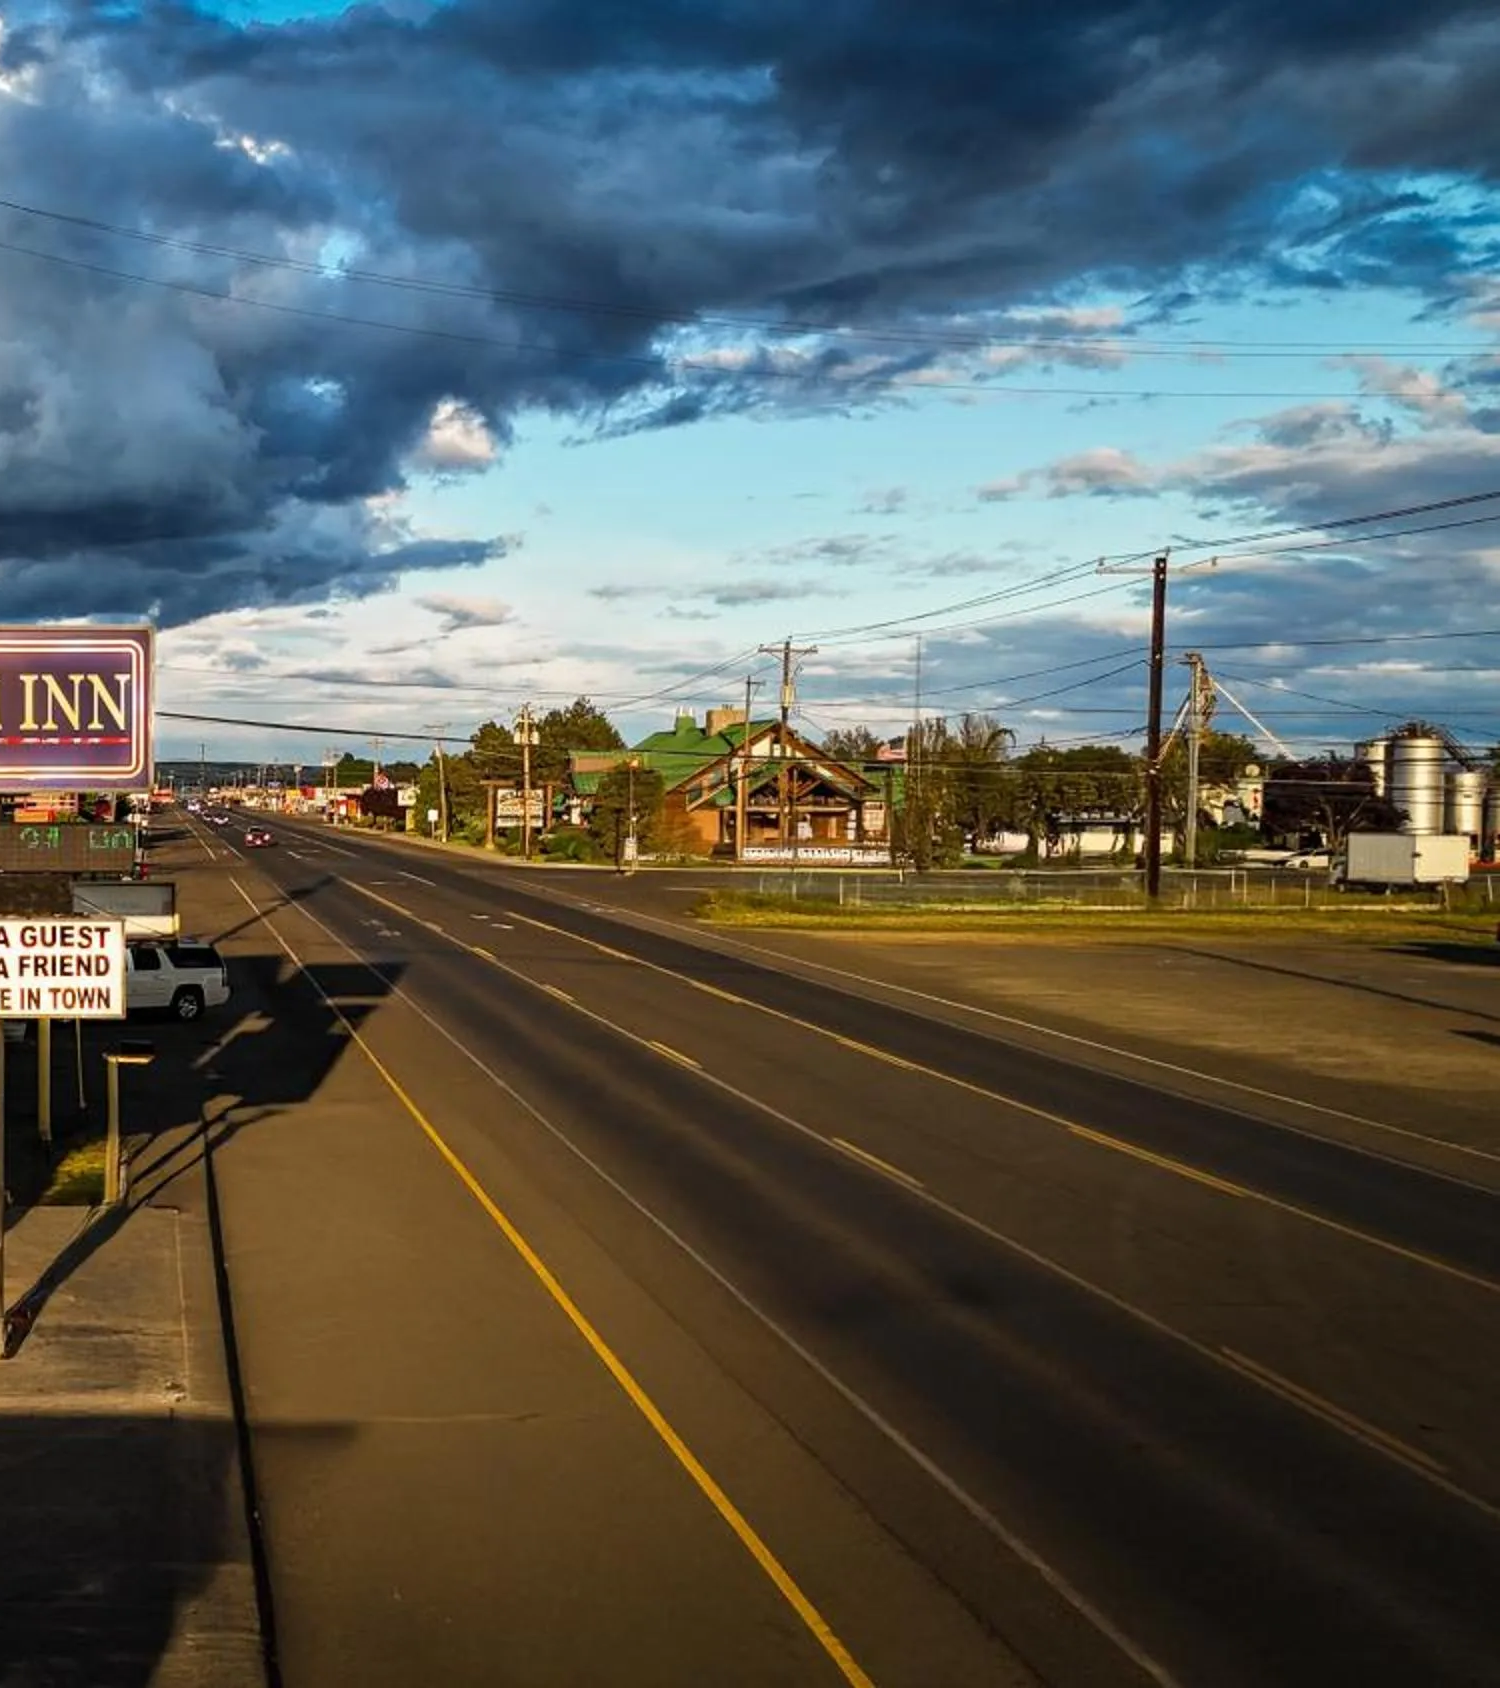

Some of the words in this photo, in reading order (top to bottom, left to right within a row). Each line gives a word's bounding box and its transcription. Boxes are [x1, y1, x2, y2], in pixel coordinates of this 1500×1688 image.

[19, 673, 131, 731] INN
[19, 926, 111, 949] GUEST
[18, 955, 110, 977] FRIEND
[20, 988, 41, 1010] IN
[48, 987, 111, 1010] TOWN
